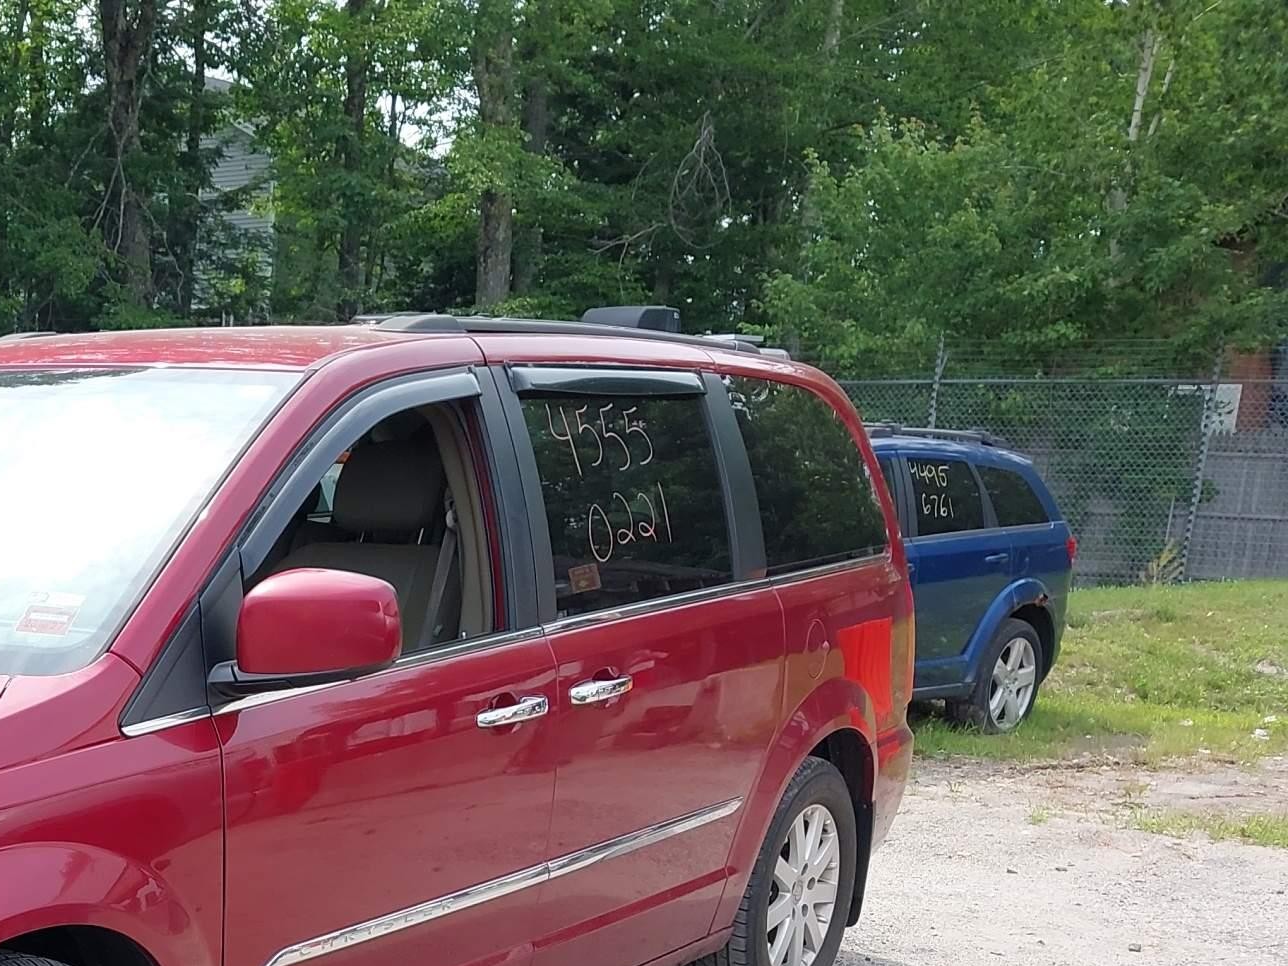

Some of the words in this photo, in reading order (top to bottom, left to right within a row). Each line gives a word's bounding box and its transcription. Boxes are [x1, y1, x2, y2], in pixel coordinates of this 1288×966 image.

[545, 403, 653, 476] 4555
[908, 461, 950, 488] 4495
[588, 481, 672, 562] 0221
[921, 493, 954, 518] 6761
